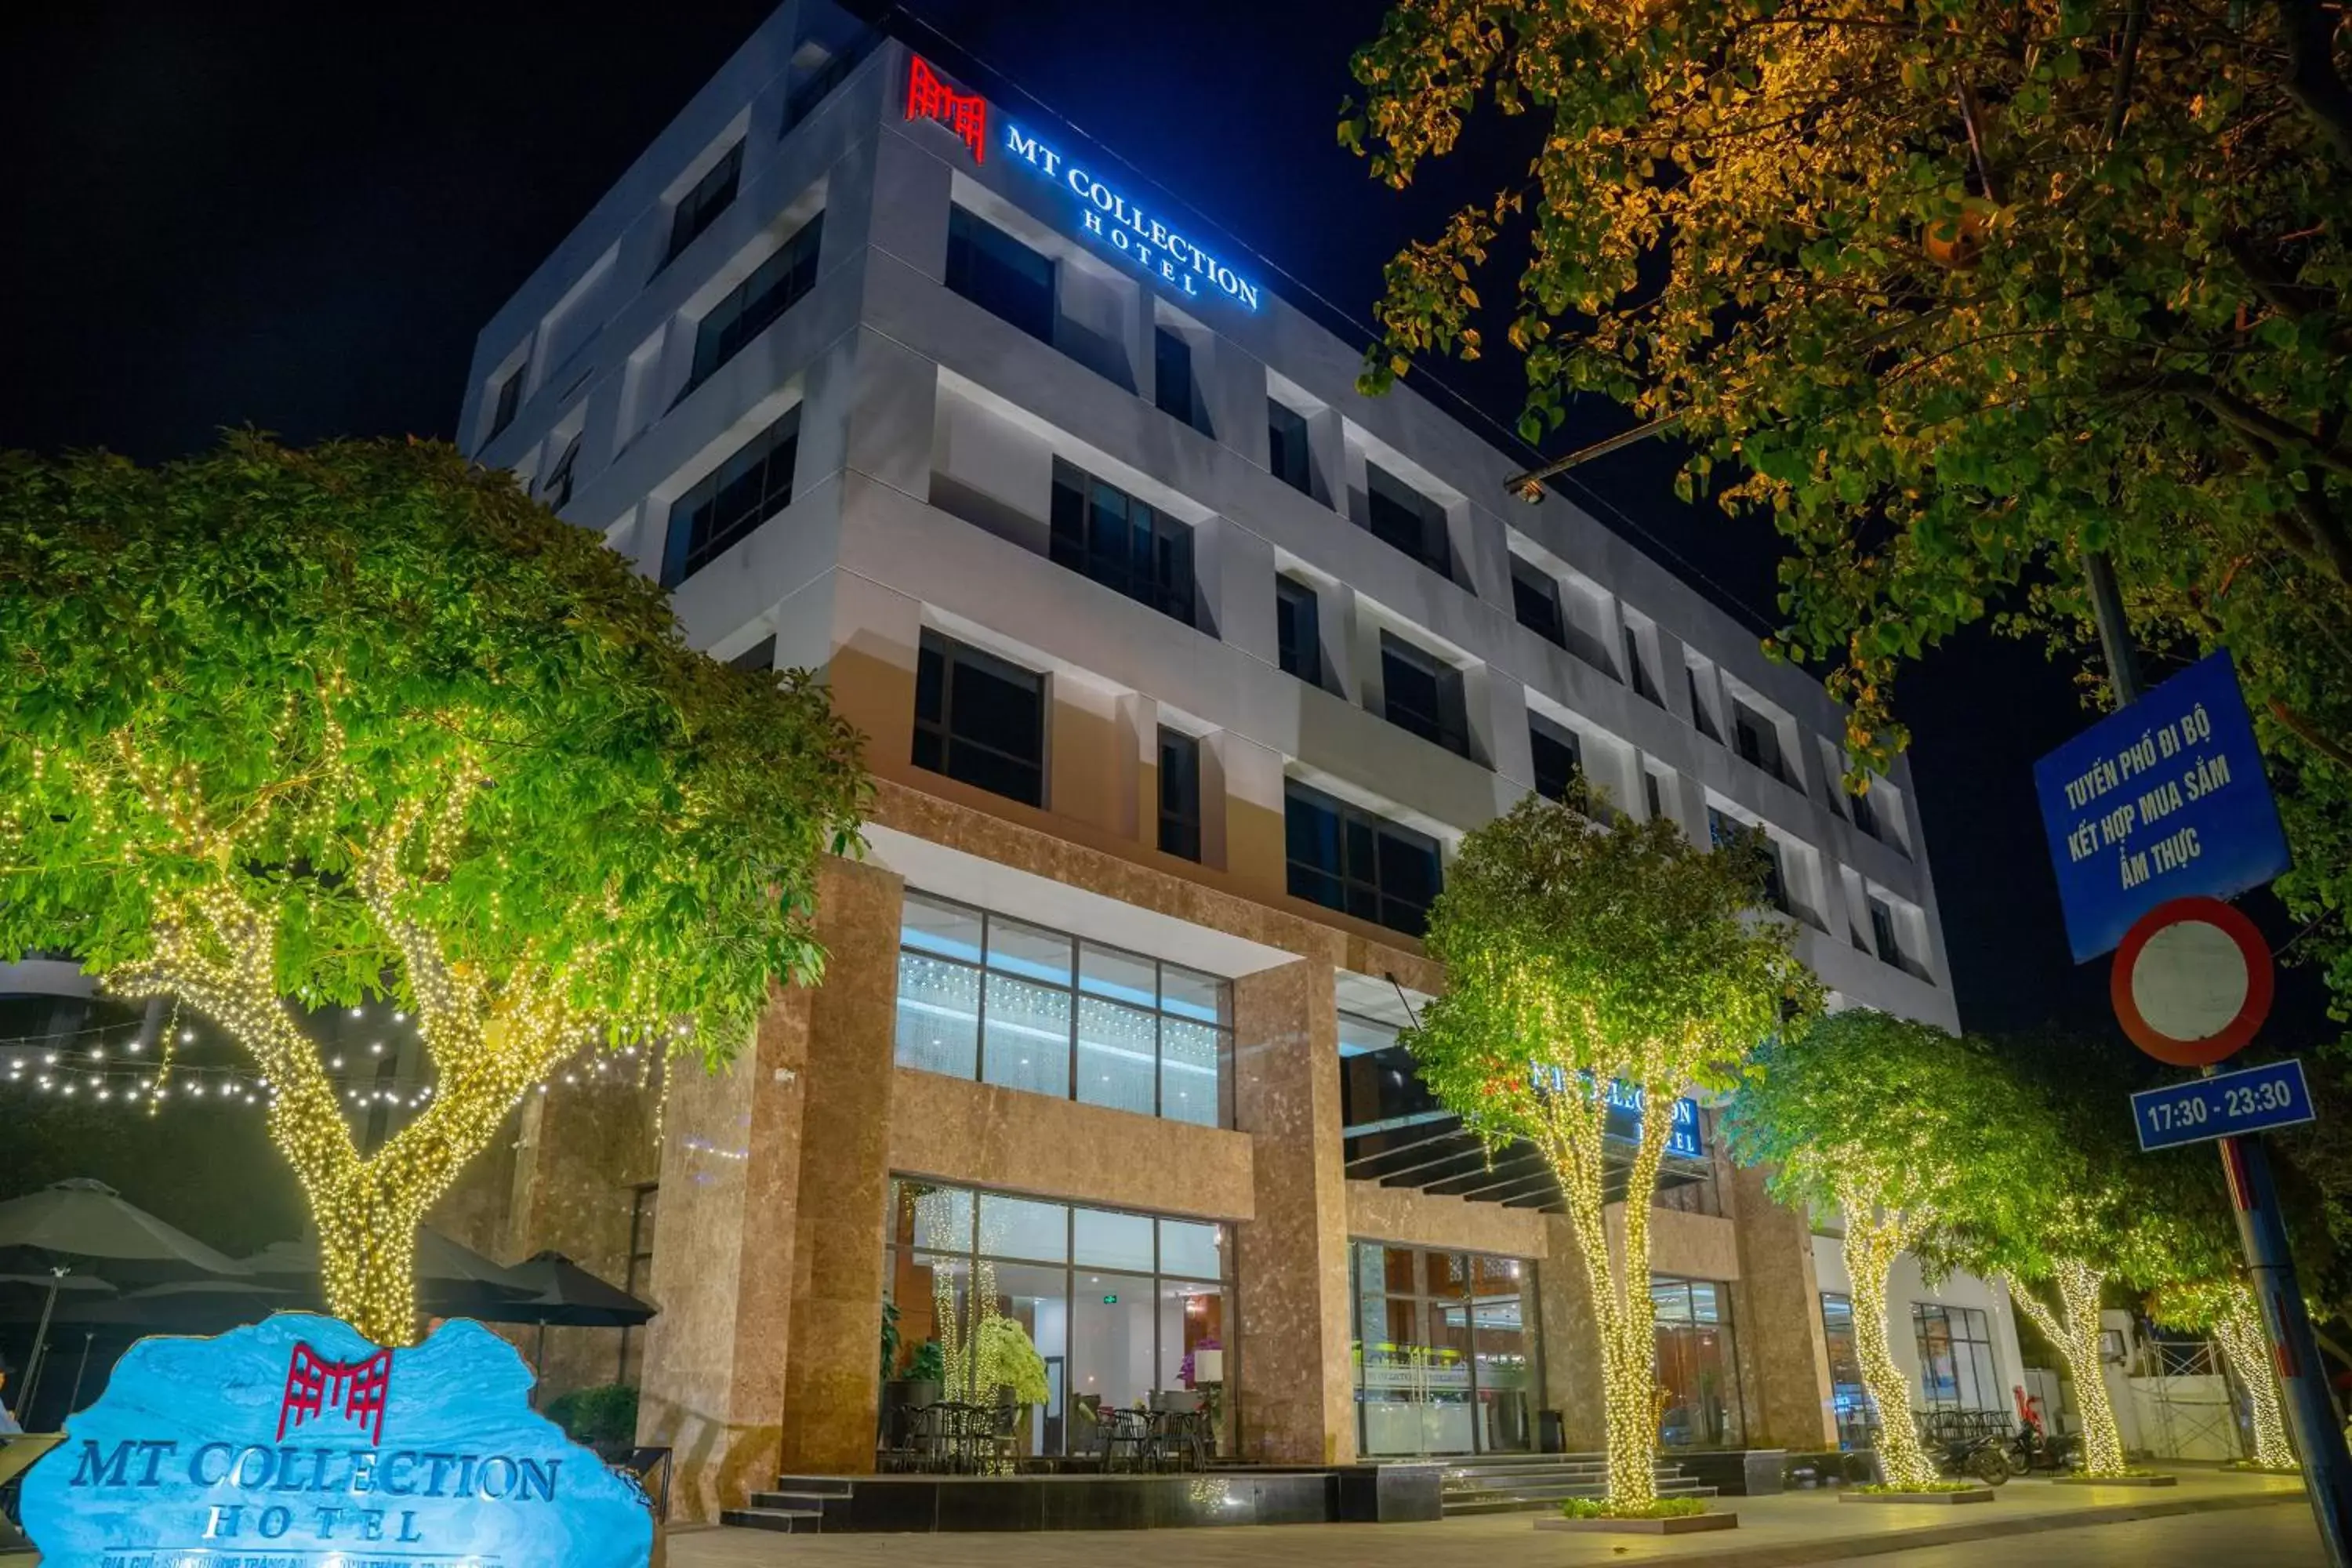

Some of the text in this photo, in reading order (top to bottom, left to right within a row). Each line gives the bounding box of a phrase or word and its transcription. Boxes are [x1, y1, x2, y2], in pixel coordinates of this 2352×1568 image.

[1007, 125, 1258, 310] MT COLLECTION
[1084, 209, 1198, 296] HOTEL
[2064, 702, 2211, 811] TUYẾN PHỐ ĐI BỘ
[2067, 754, 2231, 862] KẾT HỢP MUA SẮM
[2119, 827, 2201, 891] ẨM THỰC
[2147, 1097, 2208, 1132] 17:30
[2224, 1080, 2292, 1117] 23:30
[69, 1439, 563, 1503] MT COLLECTION
[201, 1504, 422, 1543] HOTEL
